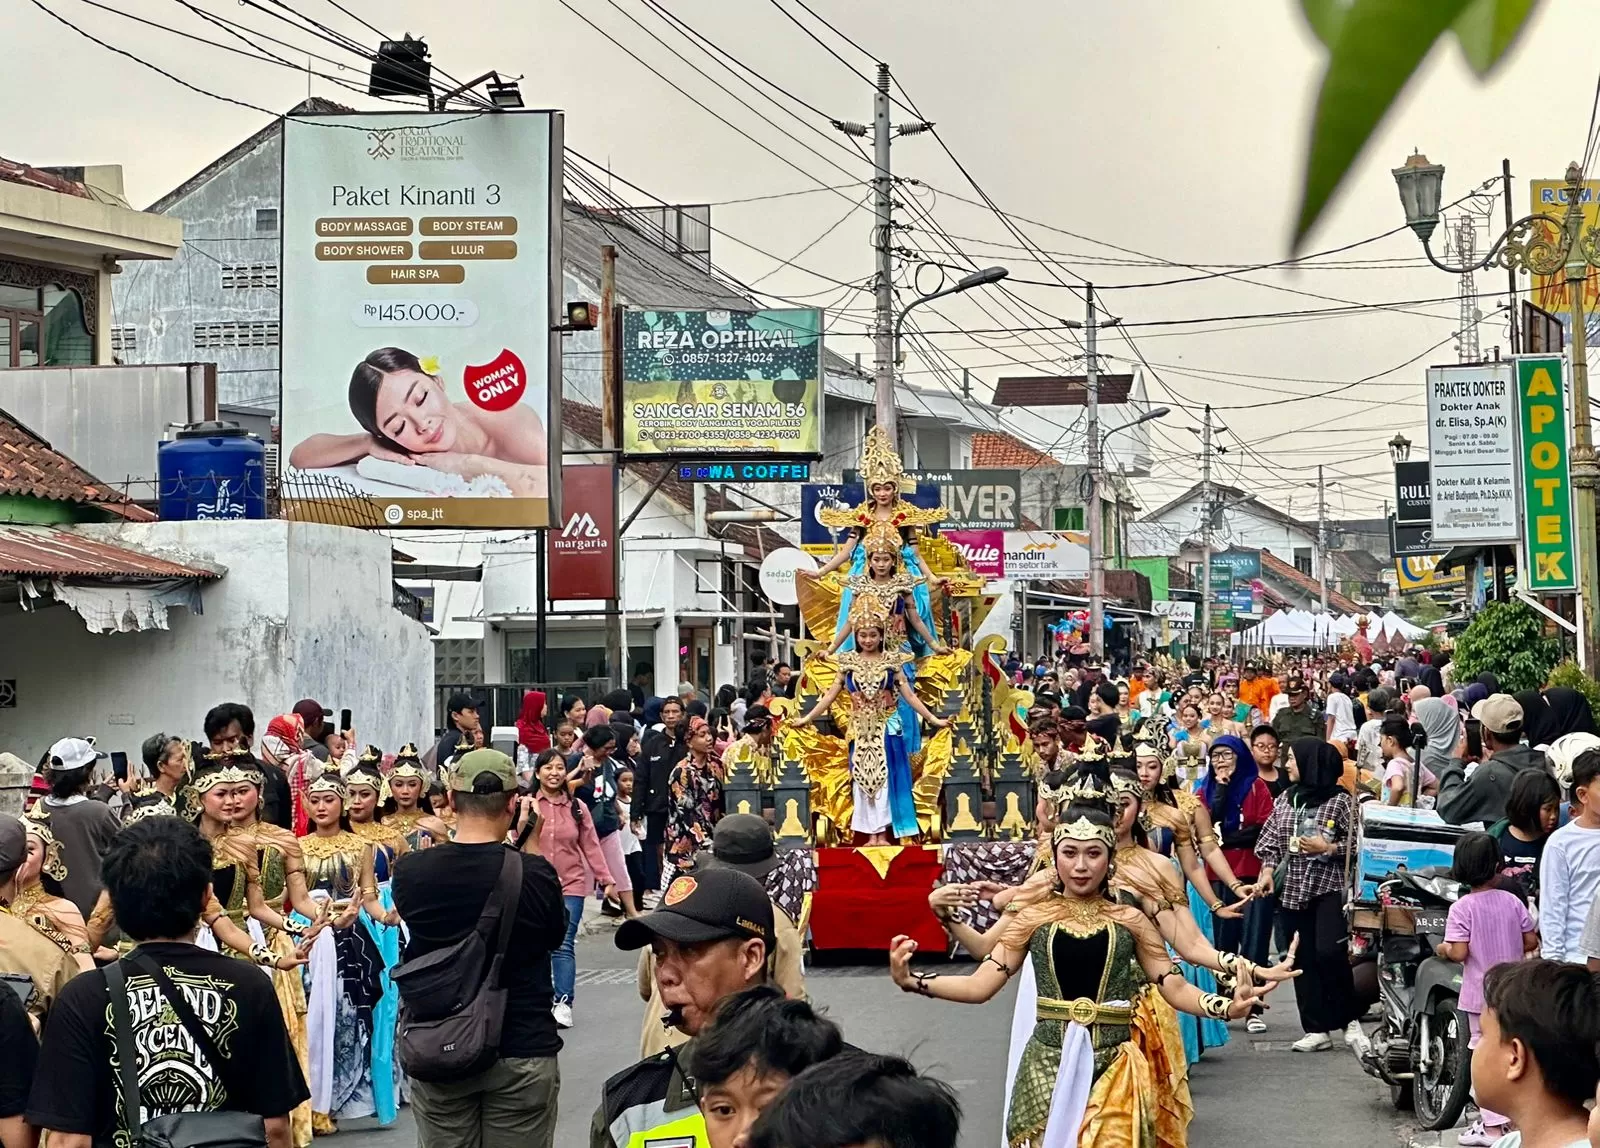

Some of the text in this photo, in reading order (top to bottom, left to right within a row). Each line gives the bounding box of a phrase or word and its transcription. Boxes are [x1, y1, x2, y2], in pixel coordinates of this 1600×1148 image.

[401, 136, 466, 146] TRADITIONAL
[401, 147, 461, 156] TREATMENT
[332, 184, 501, 206] Paket Kinanti 3
[1541, 188, 1600, 203] RUM
[320, 221, 407, 232] BODY MASSAGE
[433, 220, 503, 231] BODY STEAM
[323, 246, 405, 256] BODY SHOWER
[451, 245, 485, 255] LULUR
[390, 269, 440, 280] HAIR SPA
[638, 329, 800, 349] REZA OPTIKAL
[681, 353, 774, 364] 0857-1327-4024
[472, 363, 515, 390] WOMAN
[478, 373, 520, 402] ONLY
[1434, 380, 1506, 398] PRAKTEK DOKTER
[633, 402, 806, 418] SANGGAR SENAM 56
[1440, 402, 1501, 411] Dokter Anak
[638, 420, 674, 428] AEROBIK,
[676, 420, 699, 428] BODY
[745, 419, 769, 427] YOGA
[770, 419, 801, 427] PILATES
[1435, 416, 1507, 429] dr. Elisa, Sp.A(K)
[1527, 367, 1568, 581] APOTEK
[1436, 478, 1459, 487] Dokter
[1460, 478, 1476, 486] Kulit
[1483, 477, 1511, 485] Kelamin
[1400, 484, 1431, 499] RULL
[940, 485, 1016, 520] ILVER
[407, 508, 444, 521] spa_jtt
[554, 538, 608, 550] margaria
[766, 570, 795, 578] sadaD
[126, 985, 221, 1028] BEND
